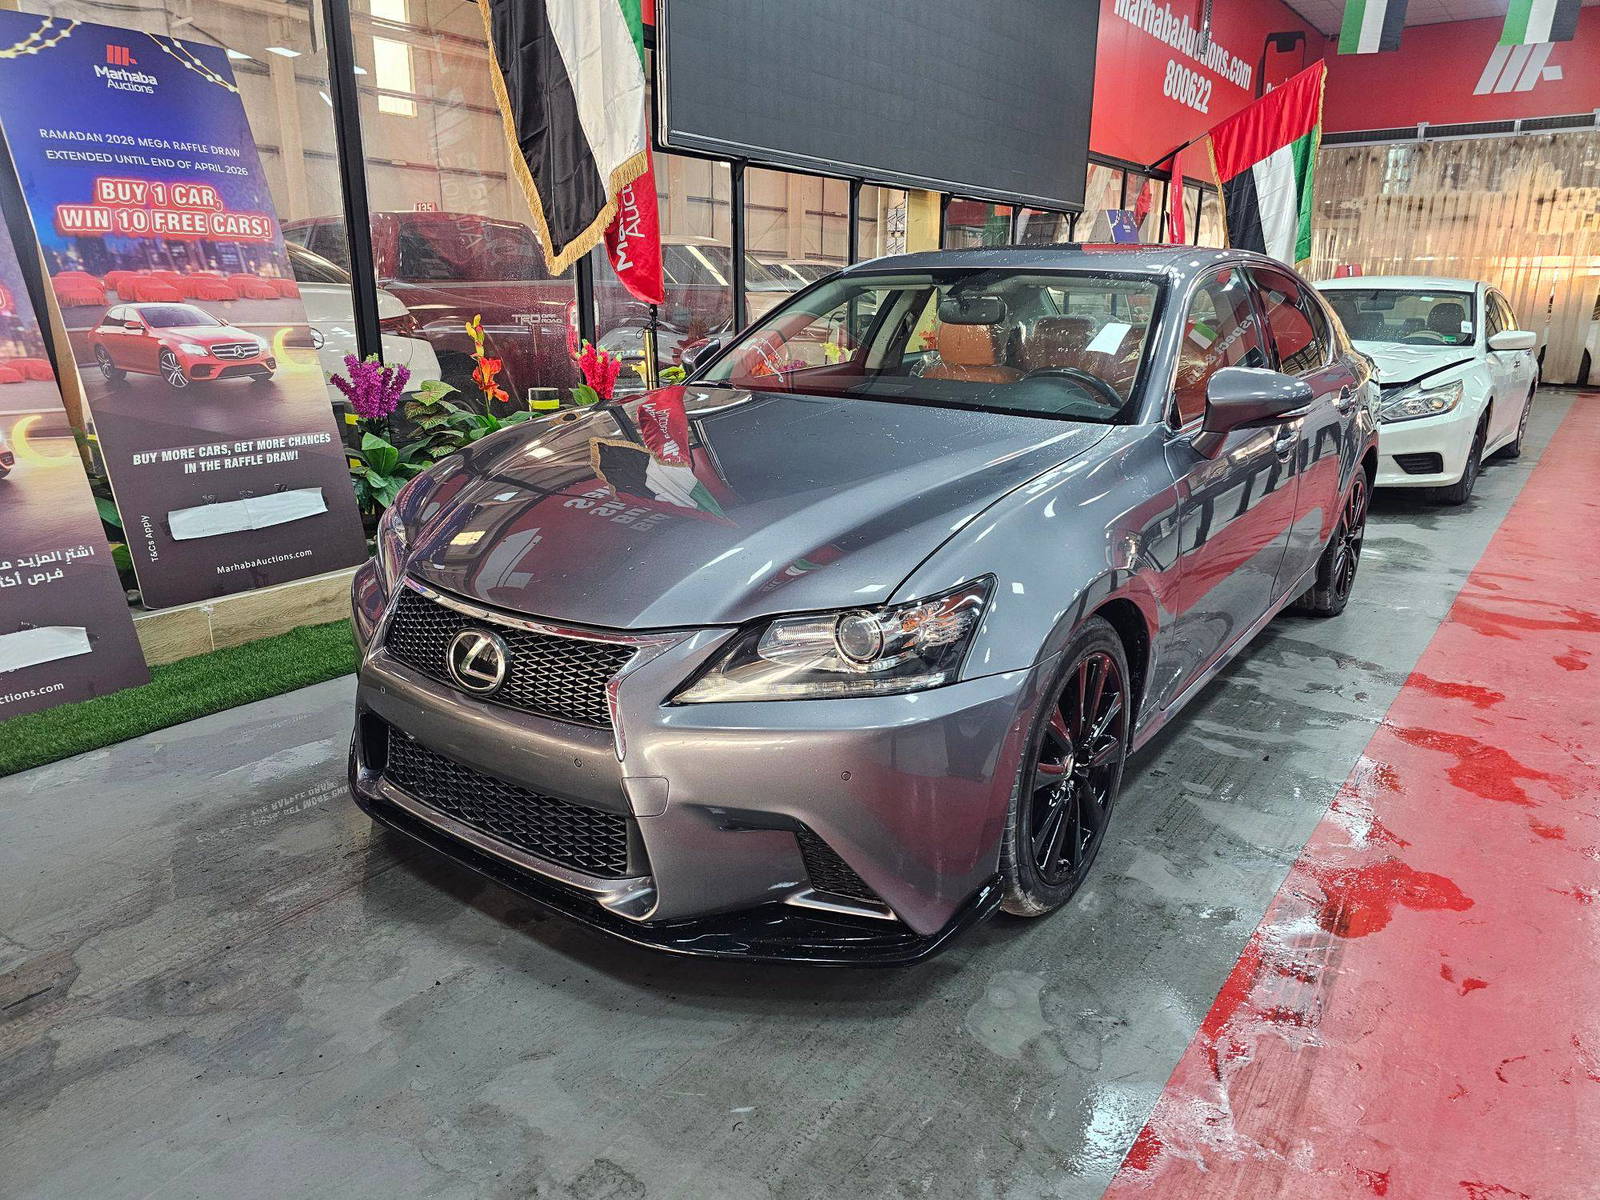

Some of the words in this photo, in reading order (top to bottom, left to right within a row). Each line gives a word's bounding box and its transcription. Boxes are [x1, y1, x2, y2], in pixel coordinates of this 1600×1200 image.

[93, 64, 158, 86] Marhaba
[107, 78, 155, 94] Auctions
[1163, 59, 1212, 115] 800622
[39, 128, 103, 143] RAMADAN
[105, 133, 135, 146] 2026
[137, 137, 171, 149] MEGA
[172, 141, 209, 153] RAFFLE
[210, 145, 240, 157] DRAW
[45, 150, 113, 163] EXTENDED
[114, 154, 150, 166] UNTIL
[150, 157, 175, 168] END
[176, 160, 192, 169] OF
[194, 162, 225, 173] APRIL
[224, 165, 249, 176] 2026
[100, 180, 146, 202] BUY
[154, 184, 165, 203] 1
[173, 185, 221, 209] CAR,
[60, 207, 110, 229] WIN
[118, 209, 147, 230] 10
[153, 211, 207, 233] FREE
[212, 214, 270, 236] CARS!
[511, 313, 541, 325] TRD
[132, 452, 157, 466] BUY
[161, 448, 195, 462] MORE
[198, 444, 231, 457] CARS,
[234, 441, 254, 453] GET
[256, 437, 286, 451] MORE
[288, 433, 331, 447] CHANCES
[184, 462, 197, 474] IN
[200, 460, 221, 472] THE
[224, 454, 263, 469] RAFFLE
[266, 450, 299, 464] DRAW!
[141, 515, 154, 539] Apply
[17, 550, 62, 568] المزيد
[148, 540, 159, 562] T&Cs
[216, 549, 313, 575] MarhabaAuctions.com
[27, 567, 64, 586] فرص
